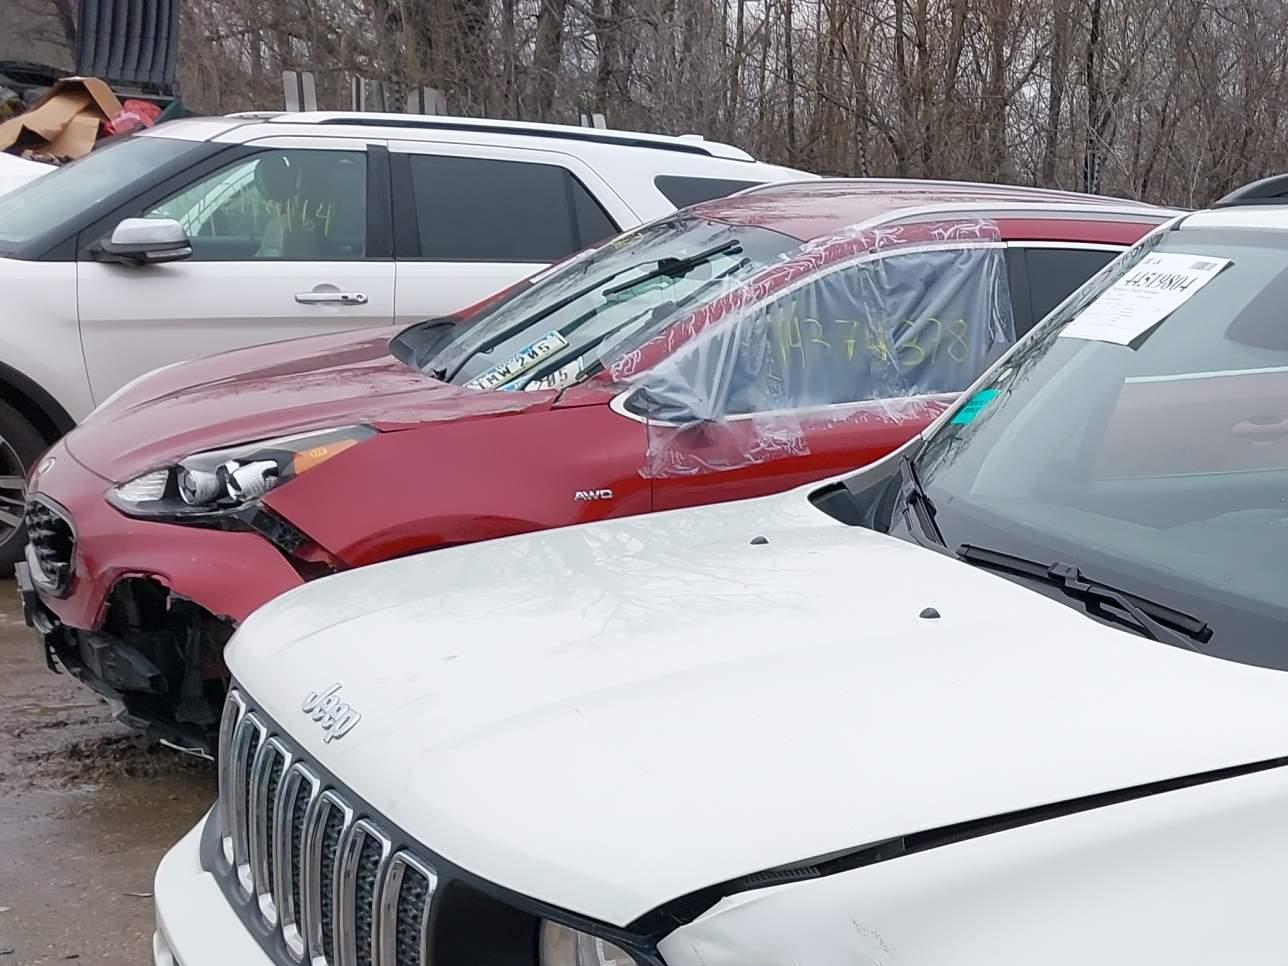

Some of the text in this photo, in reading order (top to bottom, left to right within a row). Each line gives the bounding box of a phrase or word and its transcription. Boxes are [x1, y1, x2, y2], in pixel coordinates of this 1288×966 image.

[1125, 271, 1199, 293] 44519804
[574, 489, 613, 501] AWD
[301, 682, 362, 744] Jeep
